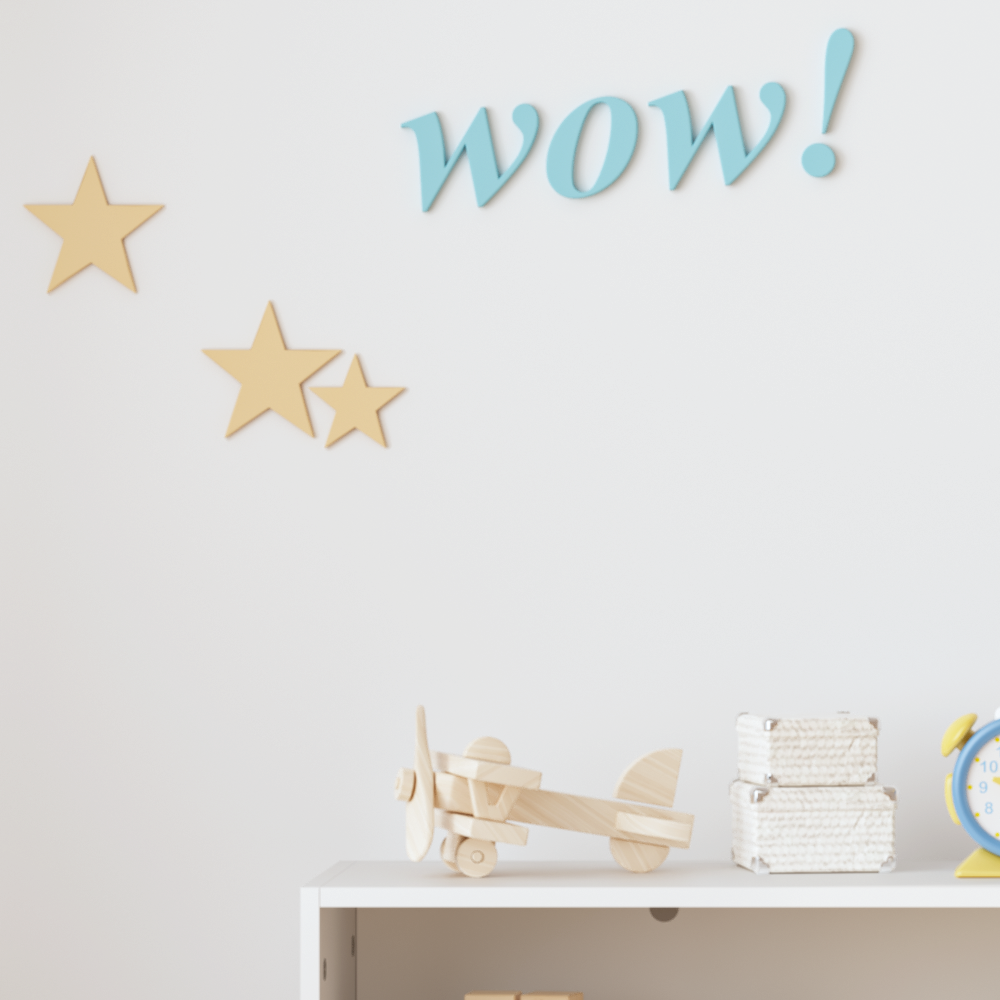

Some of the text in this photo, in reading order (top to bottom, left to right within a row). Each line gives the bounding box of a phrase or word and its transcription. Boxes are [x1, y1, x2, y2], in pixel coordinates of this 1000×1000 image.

[401, 28, 855, 213] wow!
[980, 760, 998, 773] 10
[979, 781, 988, 794] 9
[984, 802, 994, 815] 8
